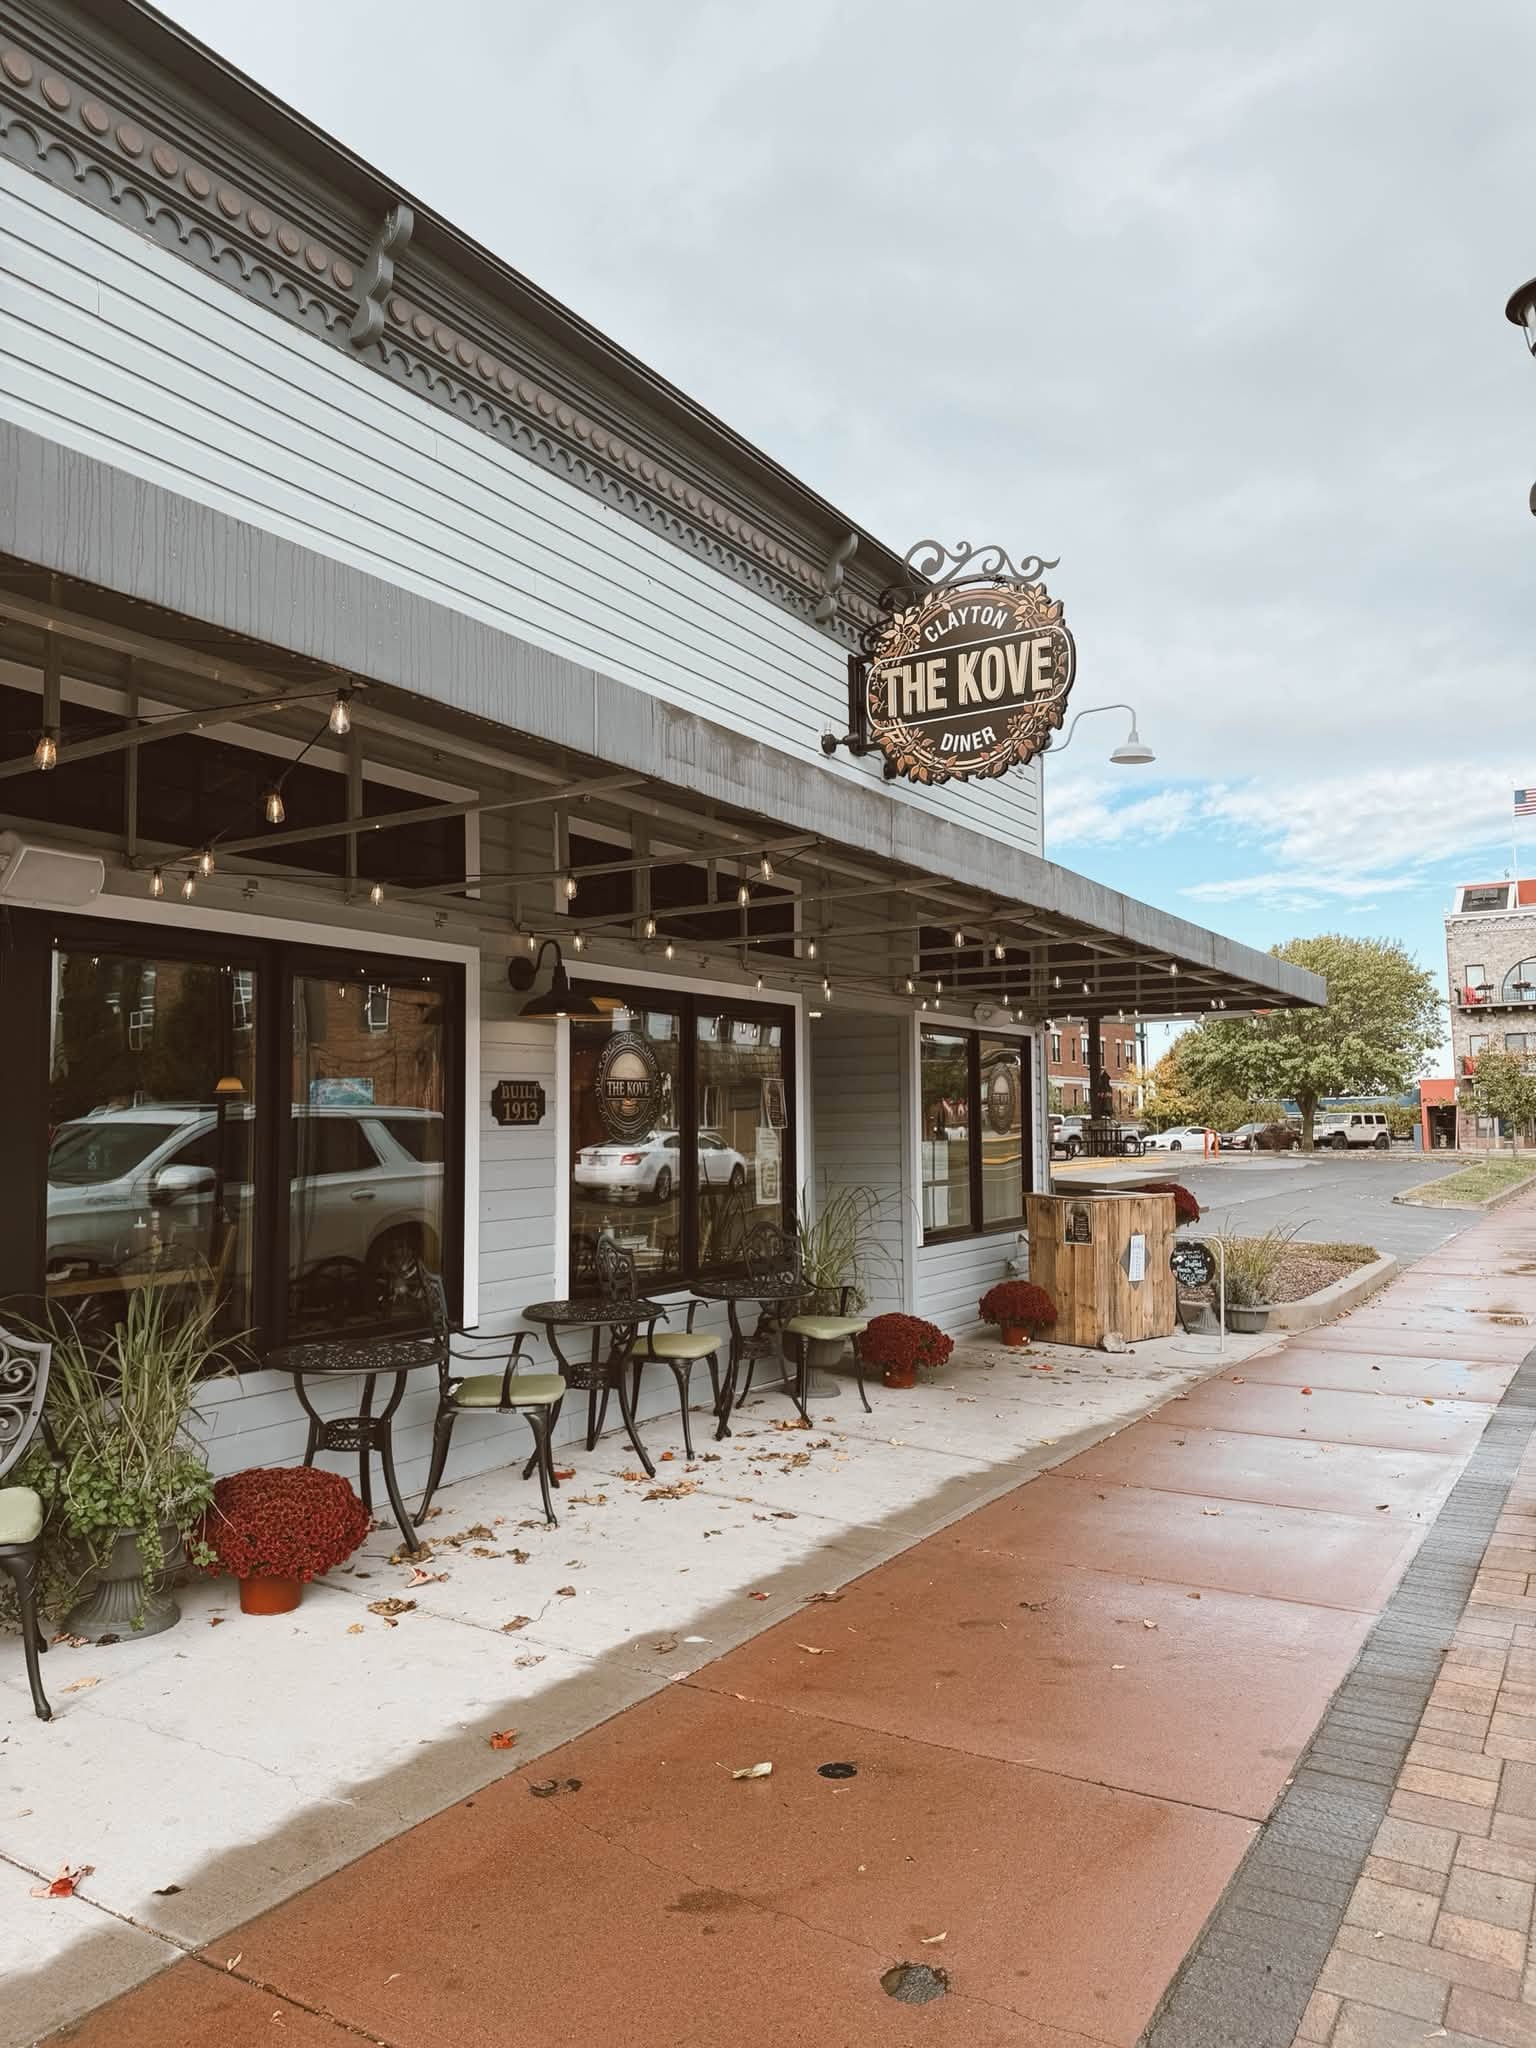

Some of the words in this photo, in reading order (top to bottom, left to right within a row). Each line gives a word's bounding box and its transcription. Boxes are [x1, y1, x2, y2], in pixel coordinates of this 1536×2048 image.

[924, 606, 1008, 643] CLAYTON
[880, 658, 947, 718] THE
[957, 637, 1053, 705] KOVE
[940, 726, 997, 753] DINER
[502, 1085, 540, 1099] BUILT
[607, 1081, 625, 1096] THE
[627, 1081, 650, 1097] KOVE
[503, 1102, 538, 1121] 1913
